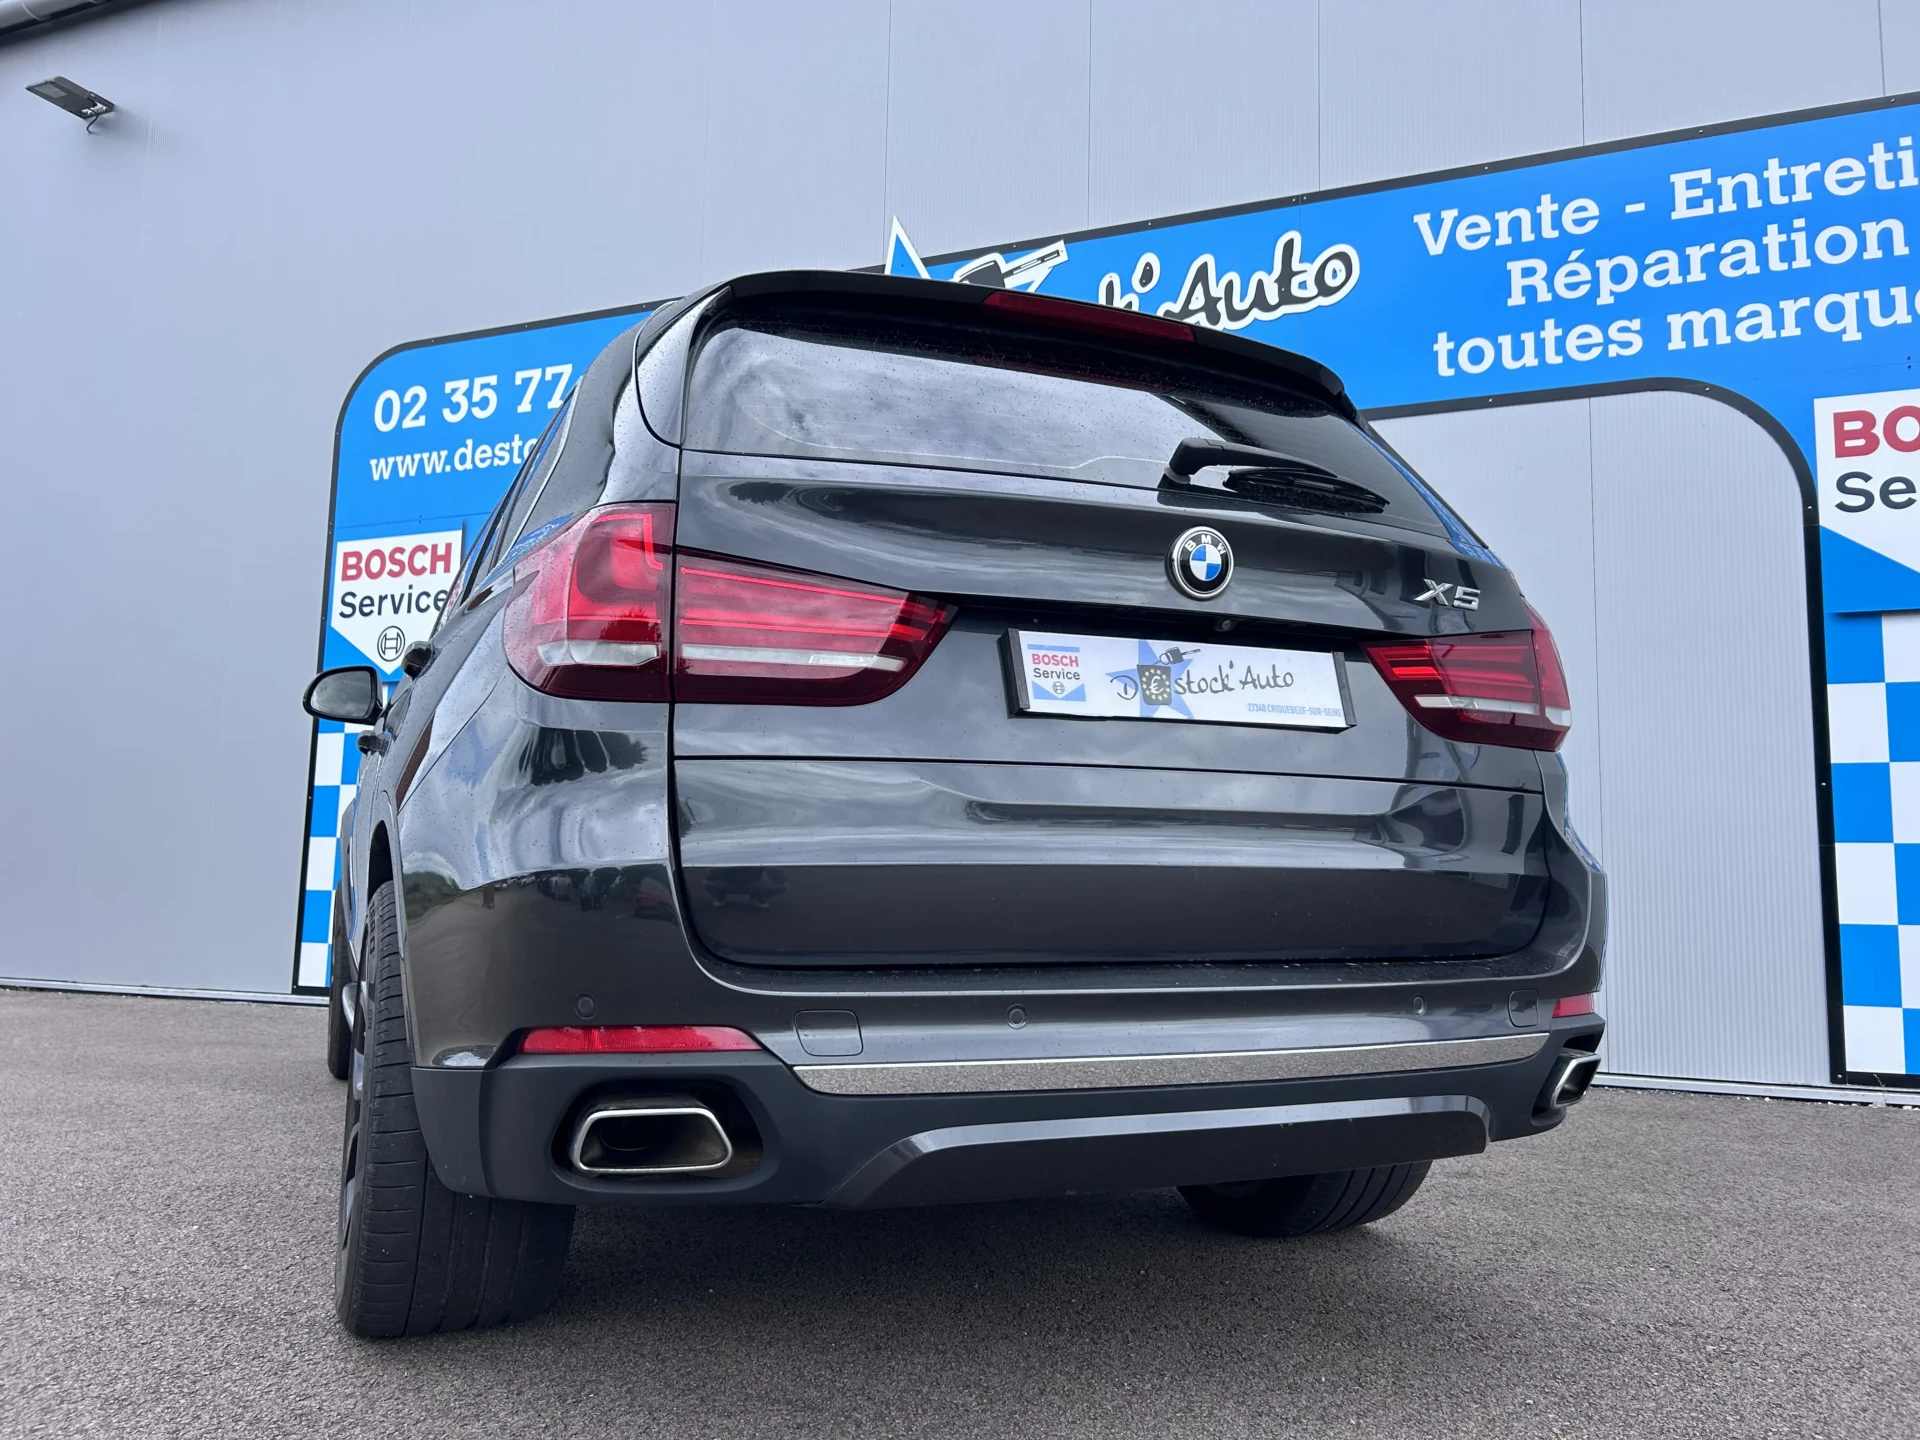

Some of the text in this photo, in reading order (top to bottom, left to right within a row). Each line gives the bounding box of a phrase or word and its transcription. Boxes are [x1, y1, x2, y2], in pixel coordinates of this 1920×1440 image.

[1413, 193, 1600, 256] Vente
[1669, 136, 1919, 220] Entreti
[1506, 216, 1909, 306] Réparation
[1433, 284, 1920, 377] toutes marqu
[374, 363, 573, 433] 02 35 77
[1833, 405, 1920, 458] BO
[1835, 471, 1918, 513] Se
[341, 542, 453, 582] BOSCH
[1184, 534, 1227, 555] BMW
[339, 584, 450, 619] Service
[1414, 578, 1481, 611] X5
[1031, 653, 1080, 667] BOSCH
[1033, 667, 1081, 680] Service
